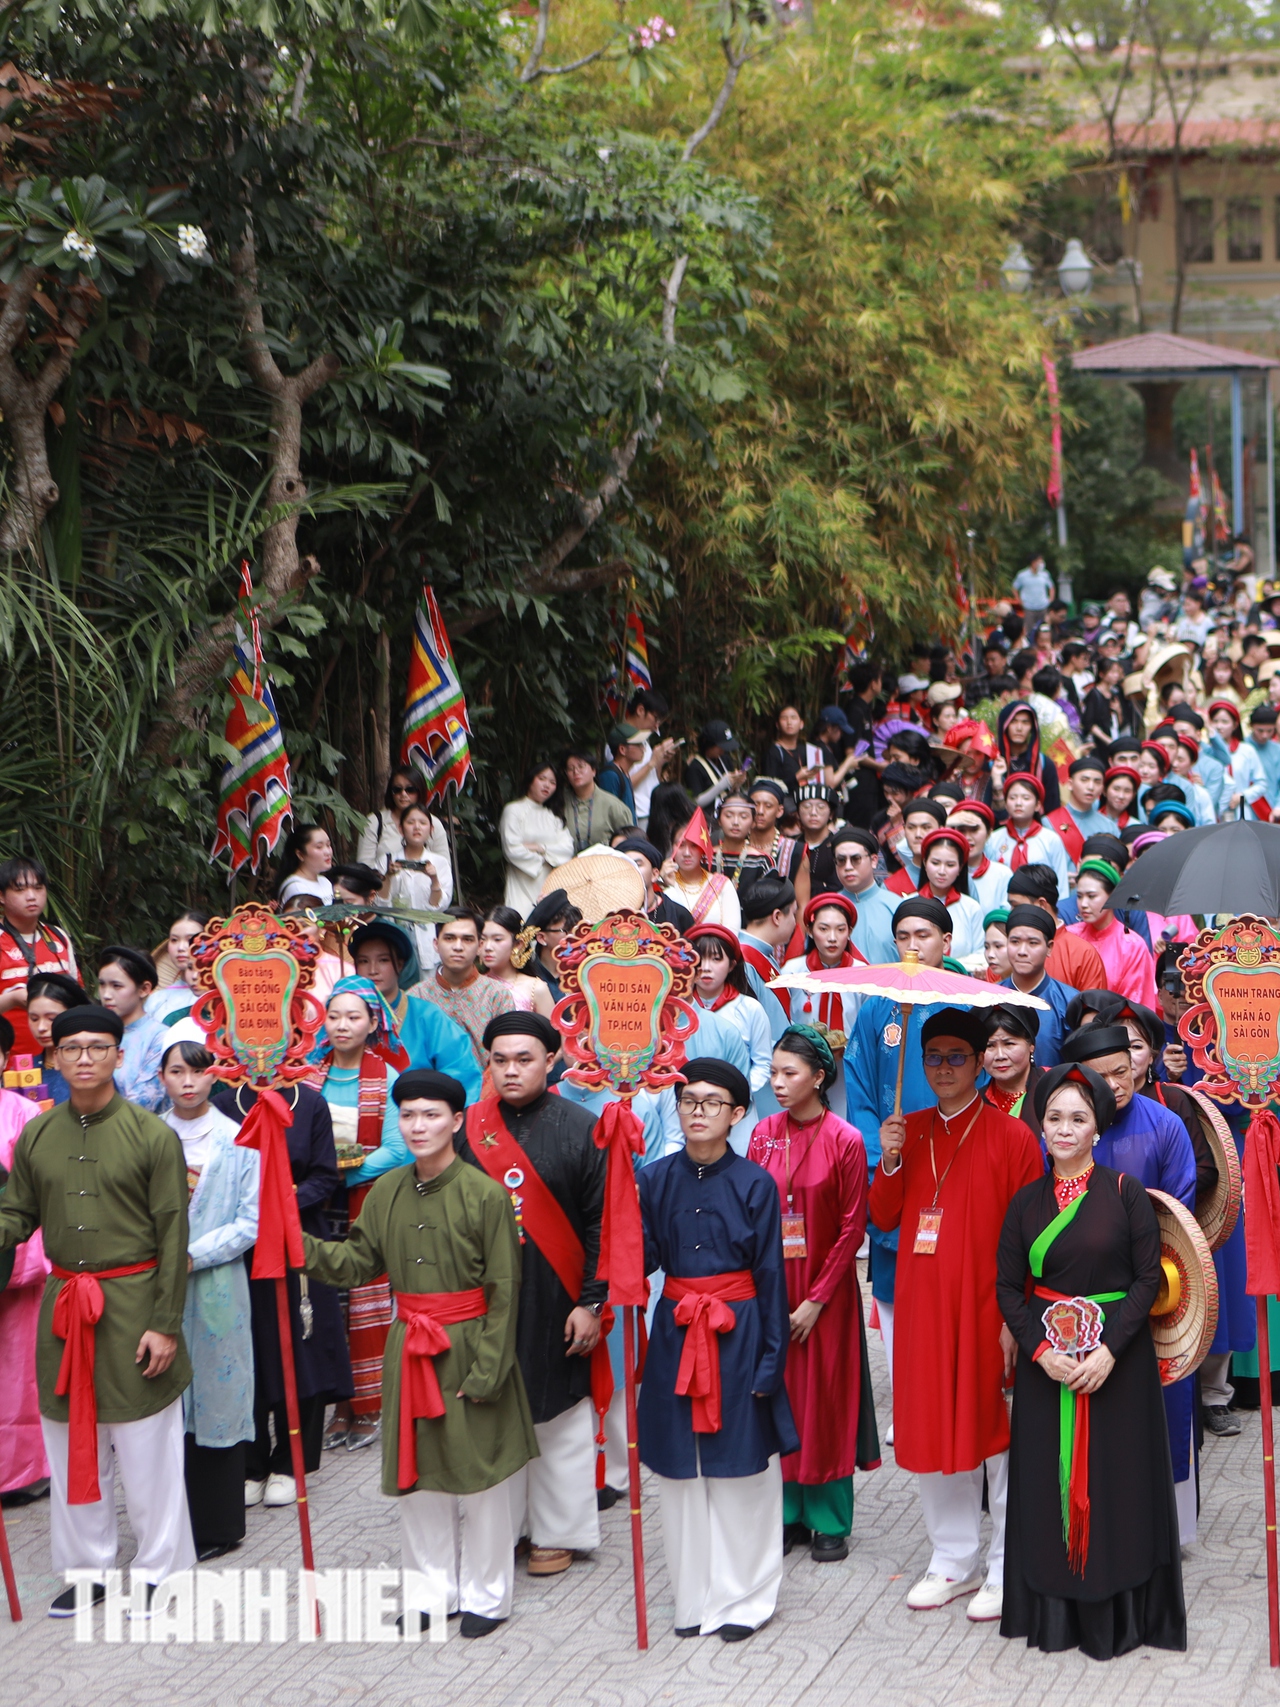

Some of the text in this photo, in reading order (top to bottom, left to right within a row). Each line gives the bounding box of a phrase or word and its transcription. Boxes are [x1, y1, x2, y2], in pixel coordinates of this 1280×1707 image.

[233, 980, 280, 997] BIỆT ĐỘNG
[600, 979, 650, 996] HỘI DI SẢN
[1219, 988, 1280, 999] THANH TRANG
[239, 999, 276, 1013] SÀI GÒN
[603, 1000, 647, 1013] VĂN HÓA
[1230, 1008, 1271, 1021] KHĂN ÁO
[238, 1018, 279, 1032] GIA ĐỊNH
[607, 1019, 643, 1031] TP.HCM
[1233, 1026, 1270, 1039] SÀI GÒN
